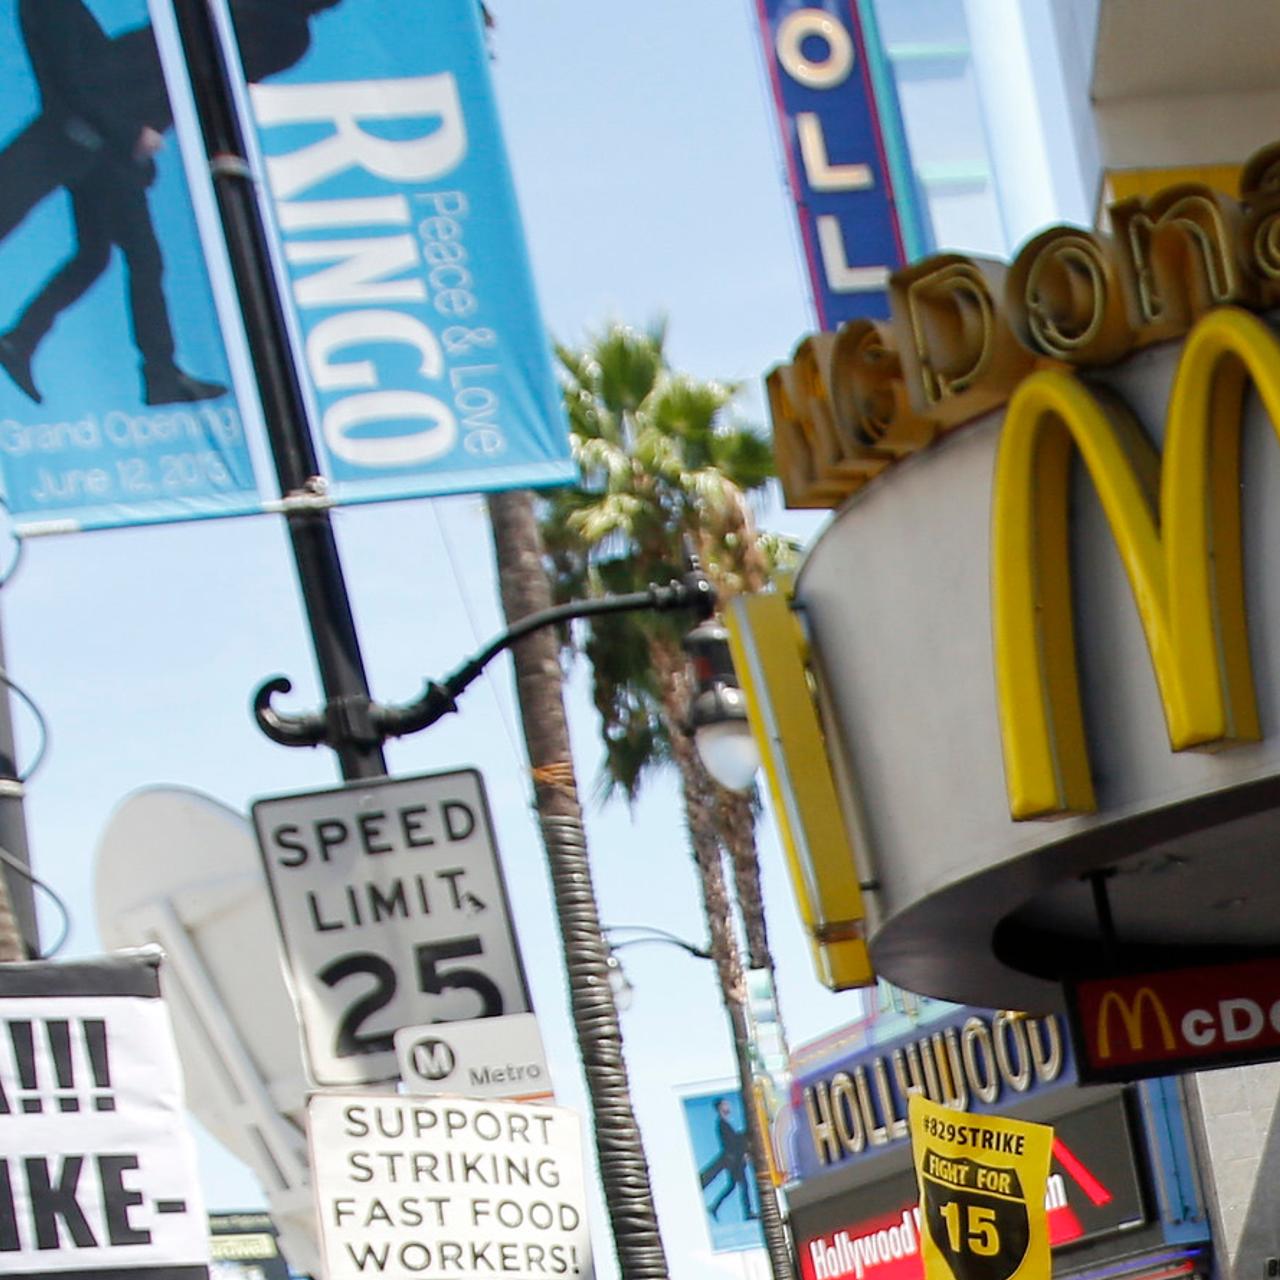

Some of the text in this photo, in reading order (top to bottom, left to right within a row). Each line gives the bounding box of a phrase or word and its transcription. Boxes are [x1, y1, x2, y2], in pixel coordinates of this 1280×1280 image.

[248, 72, 468, 468] RINGO
[414, 191, 505, 456] Peace & Love
[274, 800, 477, 868] SPEED
[306, 867, 466, 932] LIMIT
[316, 935, 504, 1059] 25
[469, 1063, 541, 1087] Metro
[344, 1104, 554, 1145] SUPPORT
[923, 1115, 1025, 1156] #829STRIKE
[348, 1151, 561, 1188] STRIKING
[929, 1154, 969, 1186] FIGHT
[976, 1165, 1011, 1194] FOR
[333, 1197, 580, 1232] FAST FOOD
[940, 1201, 1000, 1257] 15
[345, 1241, 580, 1275] WORKERS!
[810, 1210, 917, 1280] Hollywood
